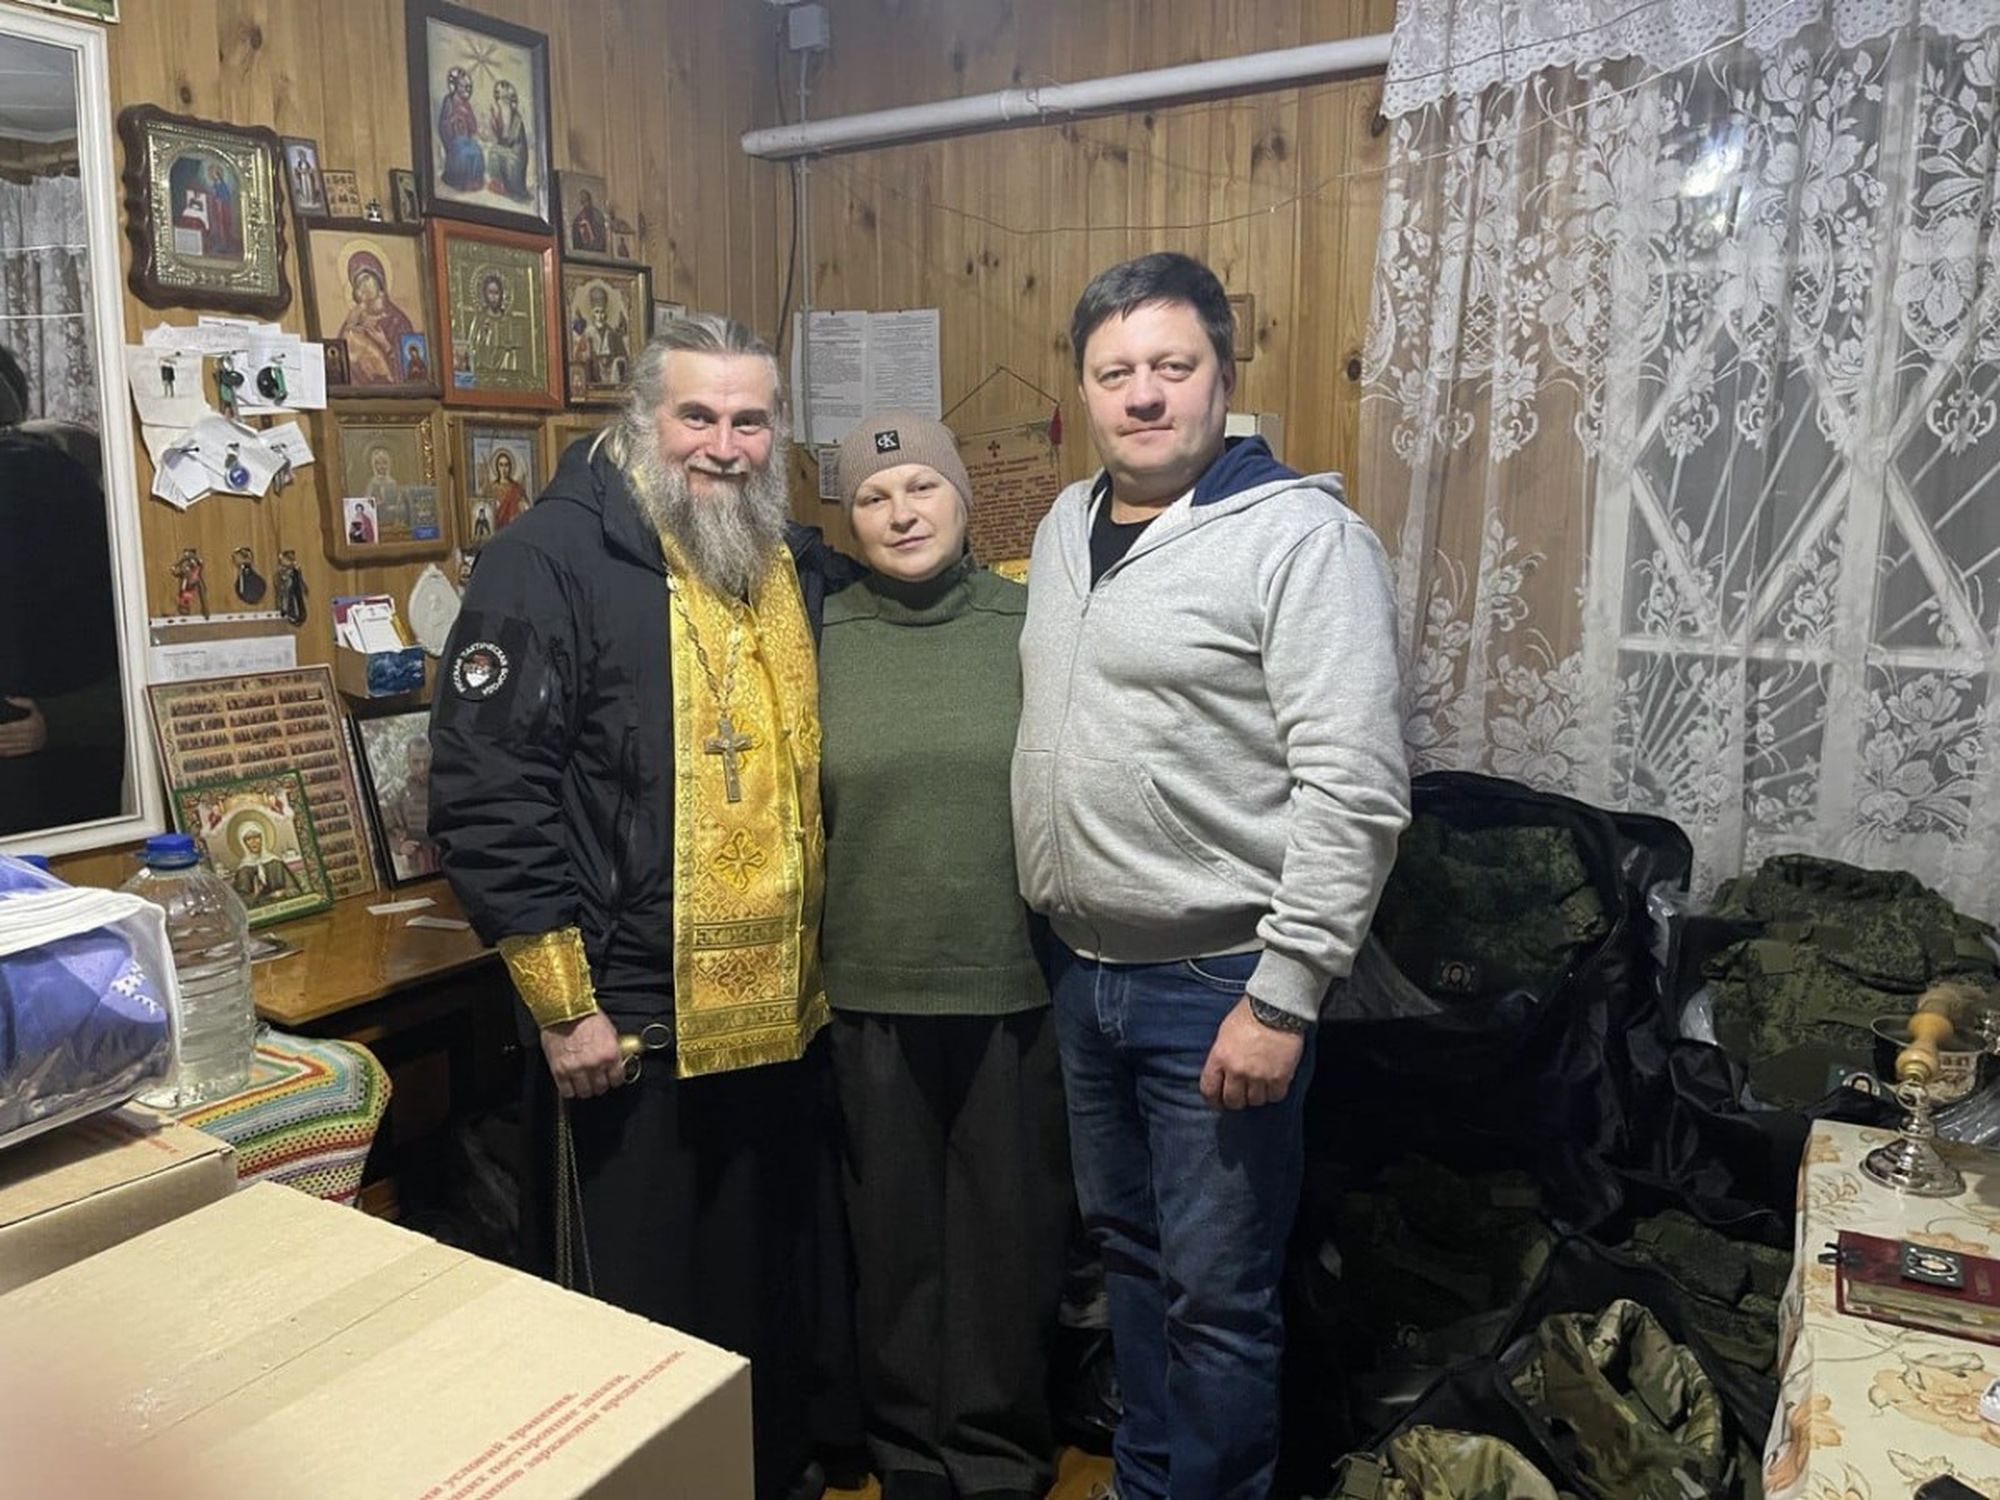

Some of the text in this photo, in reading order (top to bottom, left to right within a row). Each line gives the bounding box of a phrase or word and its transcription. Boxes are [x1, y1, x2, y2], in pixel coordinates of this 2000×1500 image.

[443, 1440, 507, 1488] условий
[507, 1391, 579, 1442] хранения.
[486, 1408, 581, 1476] посторонние
